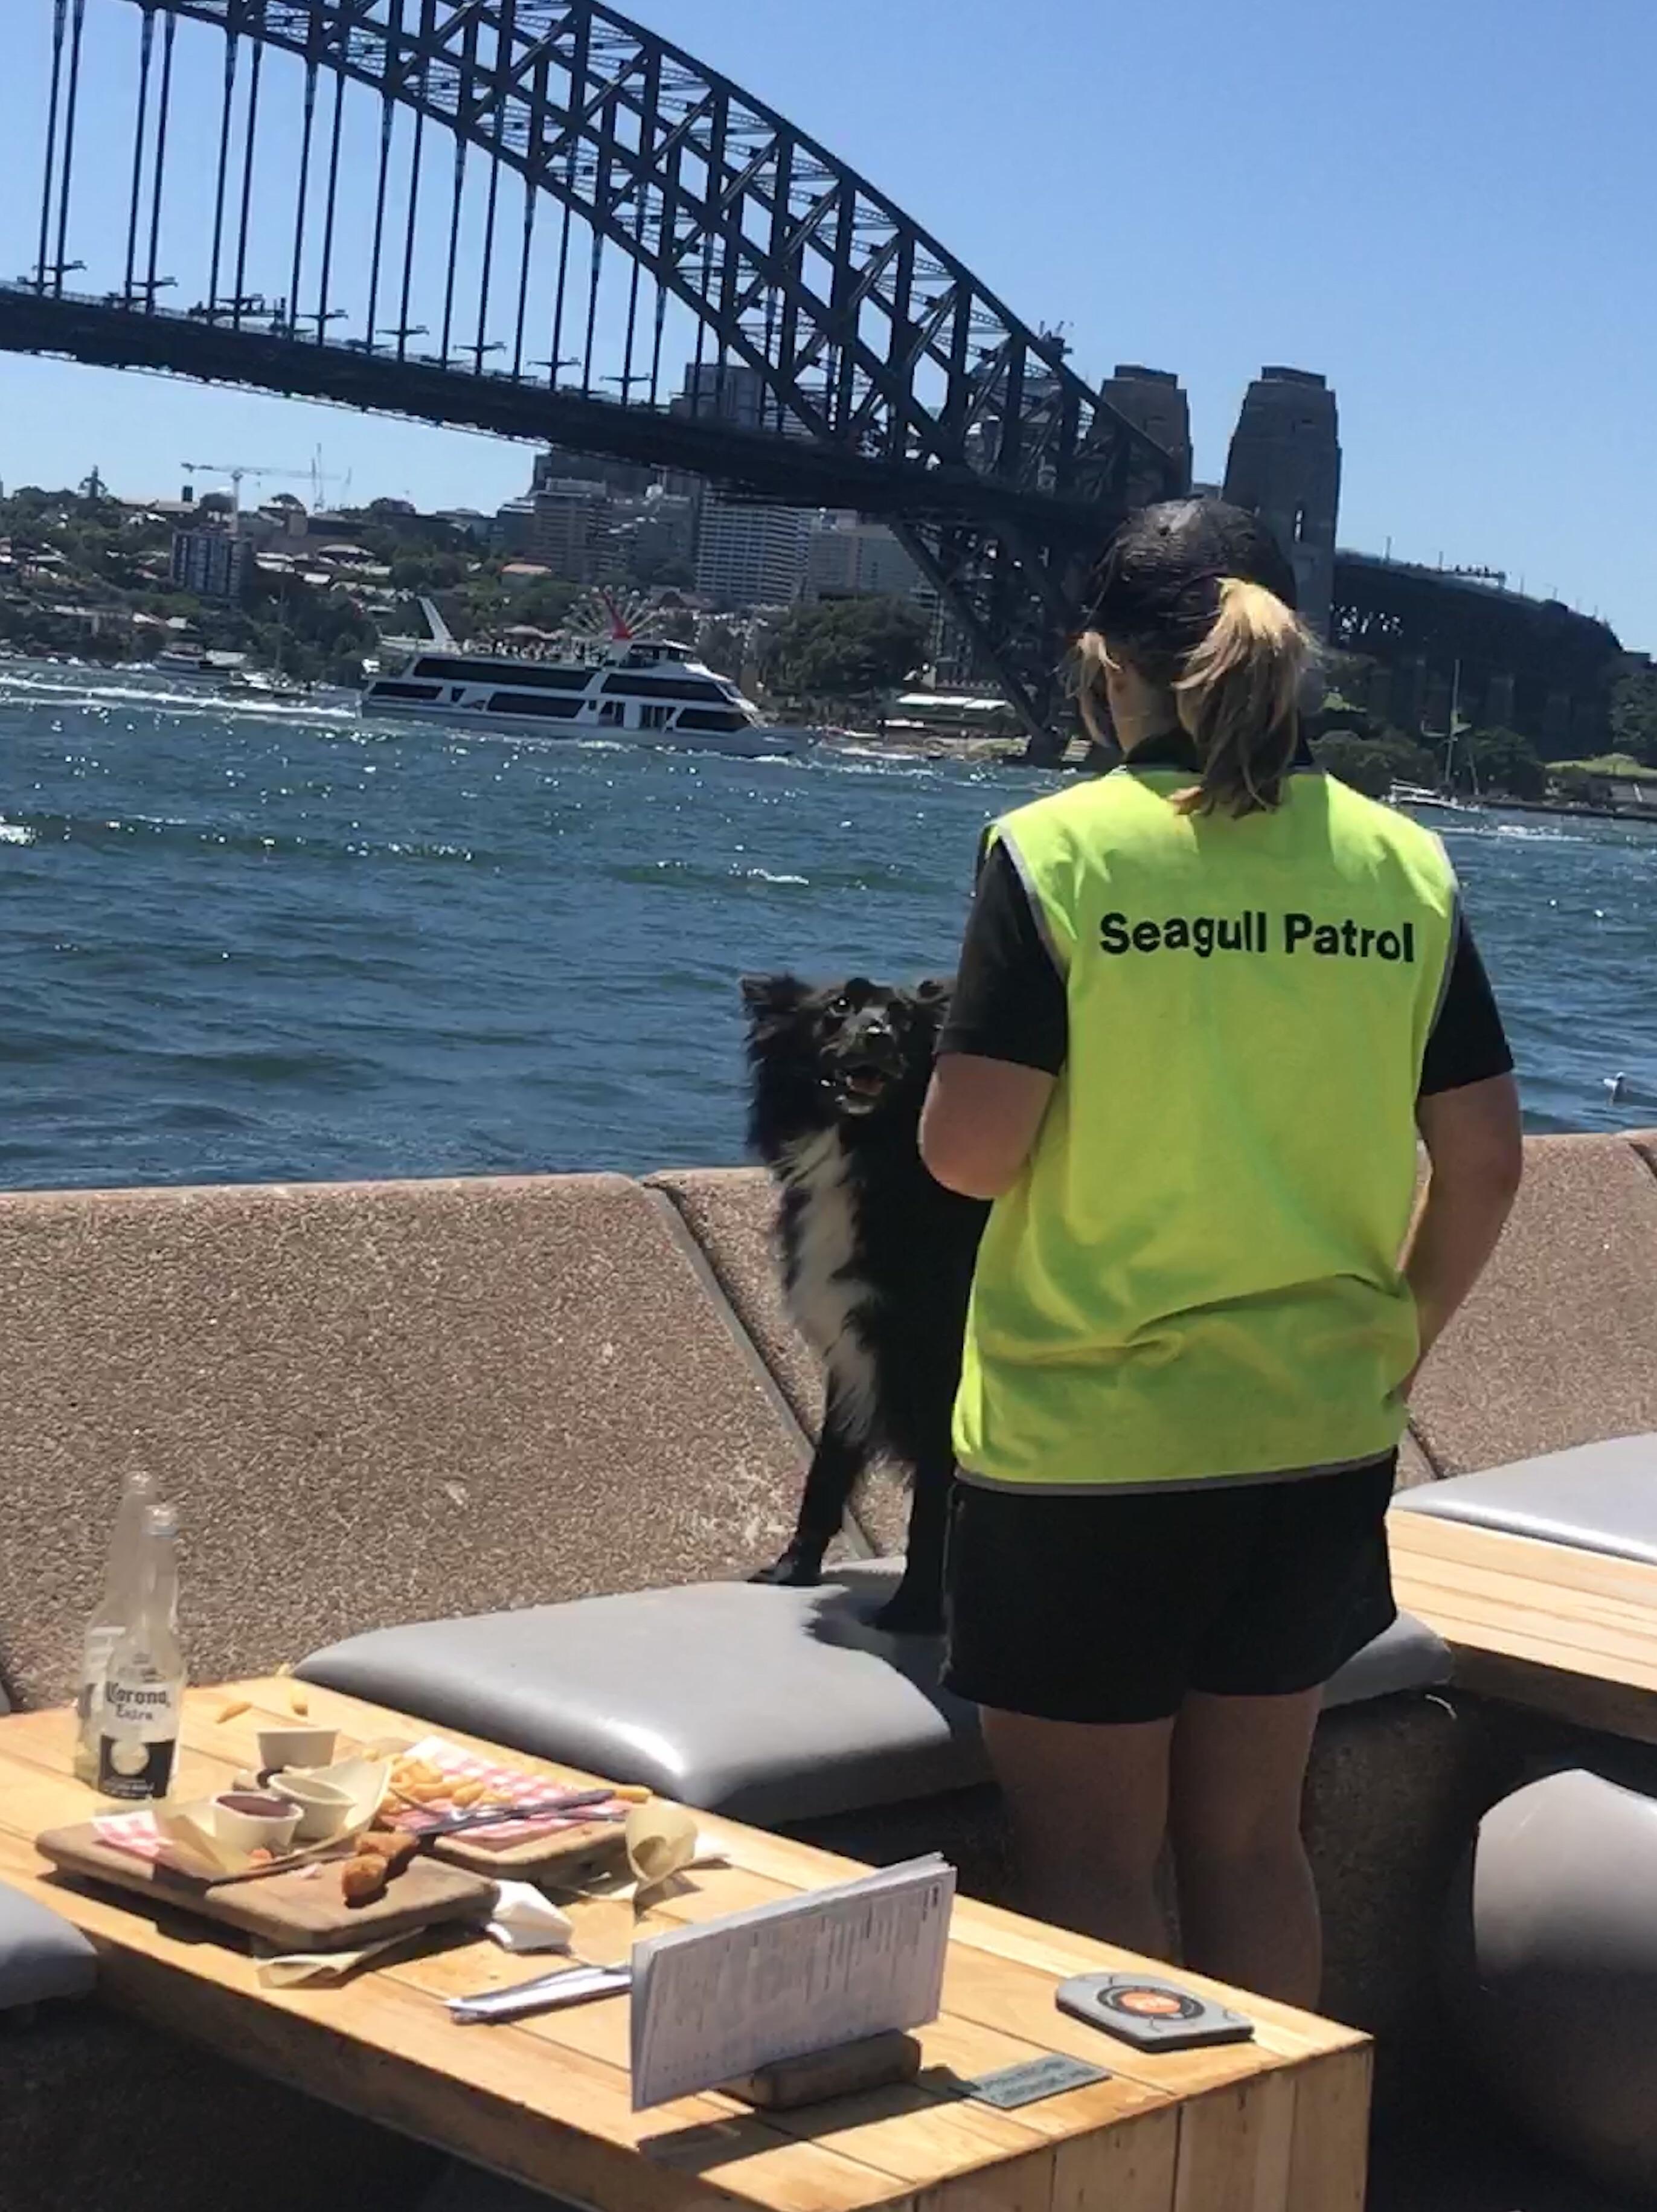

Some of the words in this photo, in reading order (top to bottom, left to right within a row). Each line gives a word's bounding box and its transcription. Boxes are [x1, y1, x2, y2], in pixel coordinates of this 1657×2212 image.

[1100, 911, 1267, 957] Seagull
[1284, 913, 1414, 963] Patrol
[104, 1681, 167, 1705] Corona
